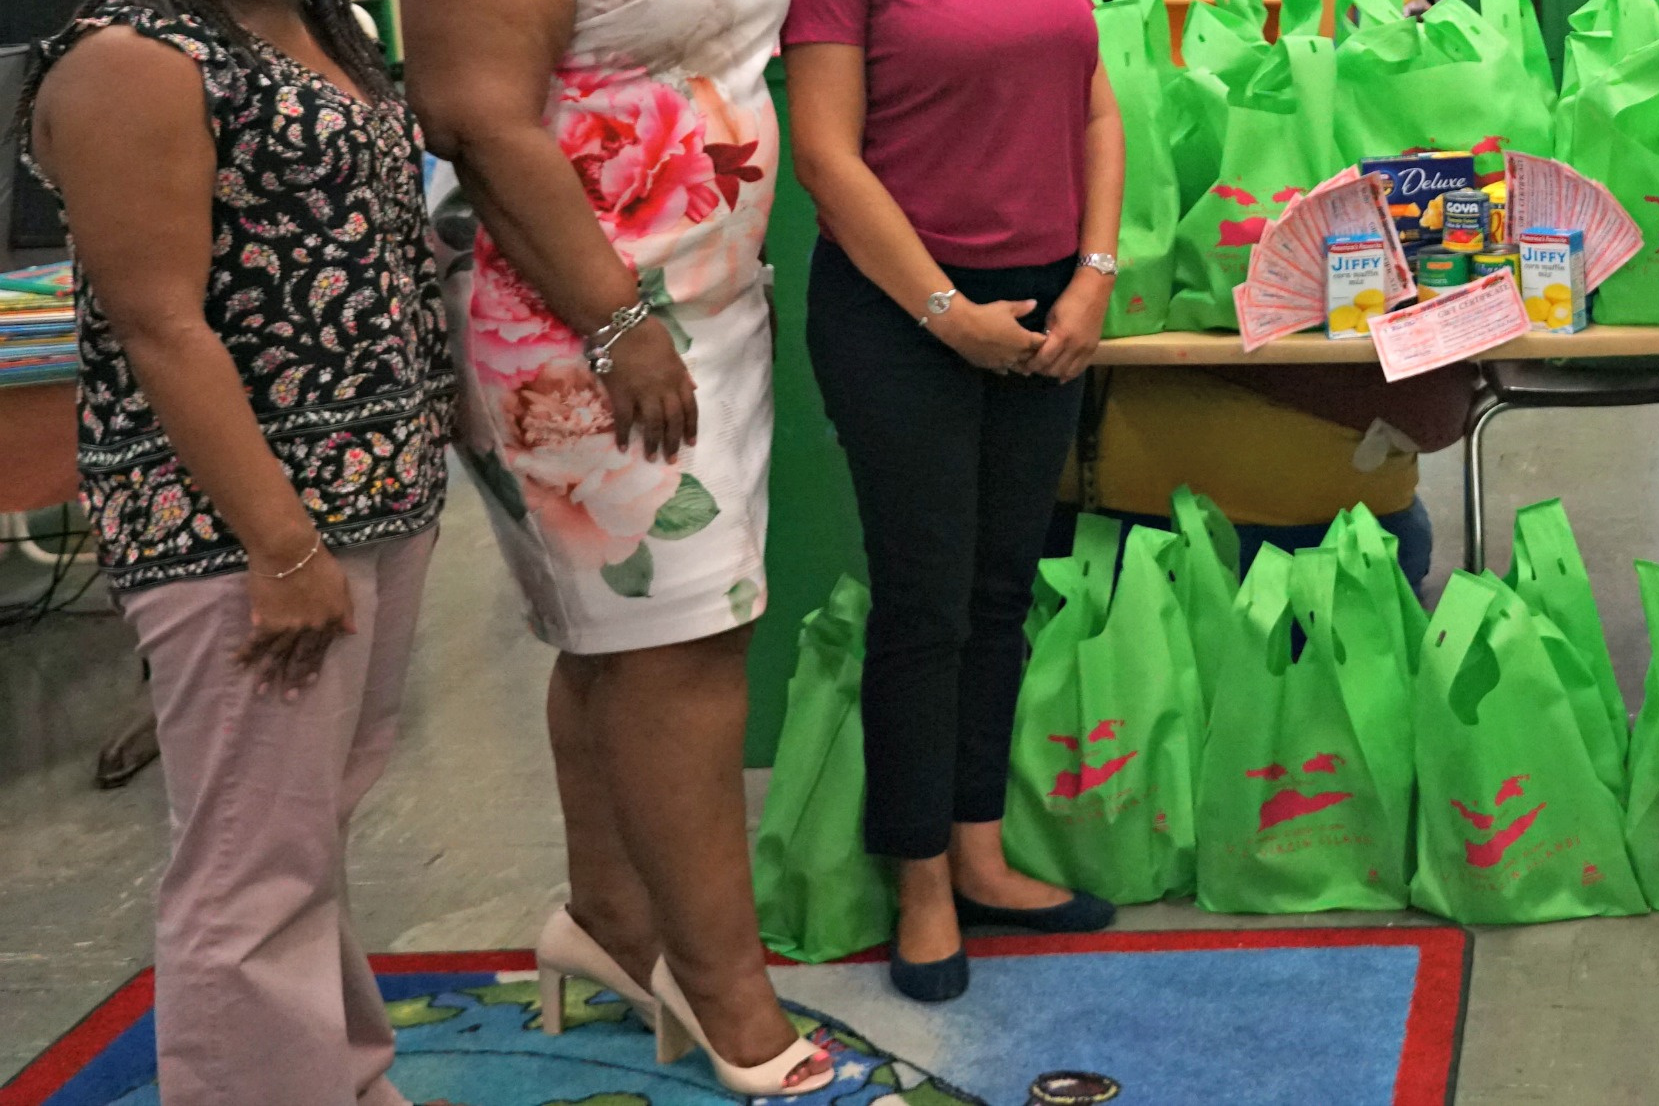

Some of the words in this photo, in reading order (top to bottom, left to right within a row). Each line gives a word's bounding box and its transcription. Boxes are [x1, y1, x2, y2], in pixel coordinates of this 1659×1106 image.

[1398, 167, 1468, 196] Deluxe
[1446, 202, 1479, 213] GOYA
[1522, 247, 1566, 263] JIFFY
[1331, 257, 1380, 272] JIFFY
[1437, 305, 1457, 319] GIFT
[1458, 283, 1511, 311] CERTIFICATE
